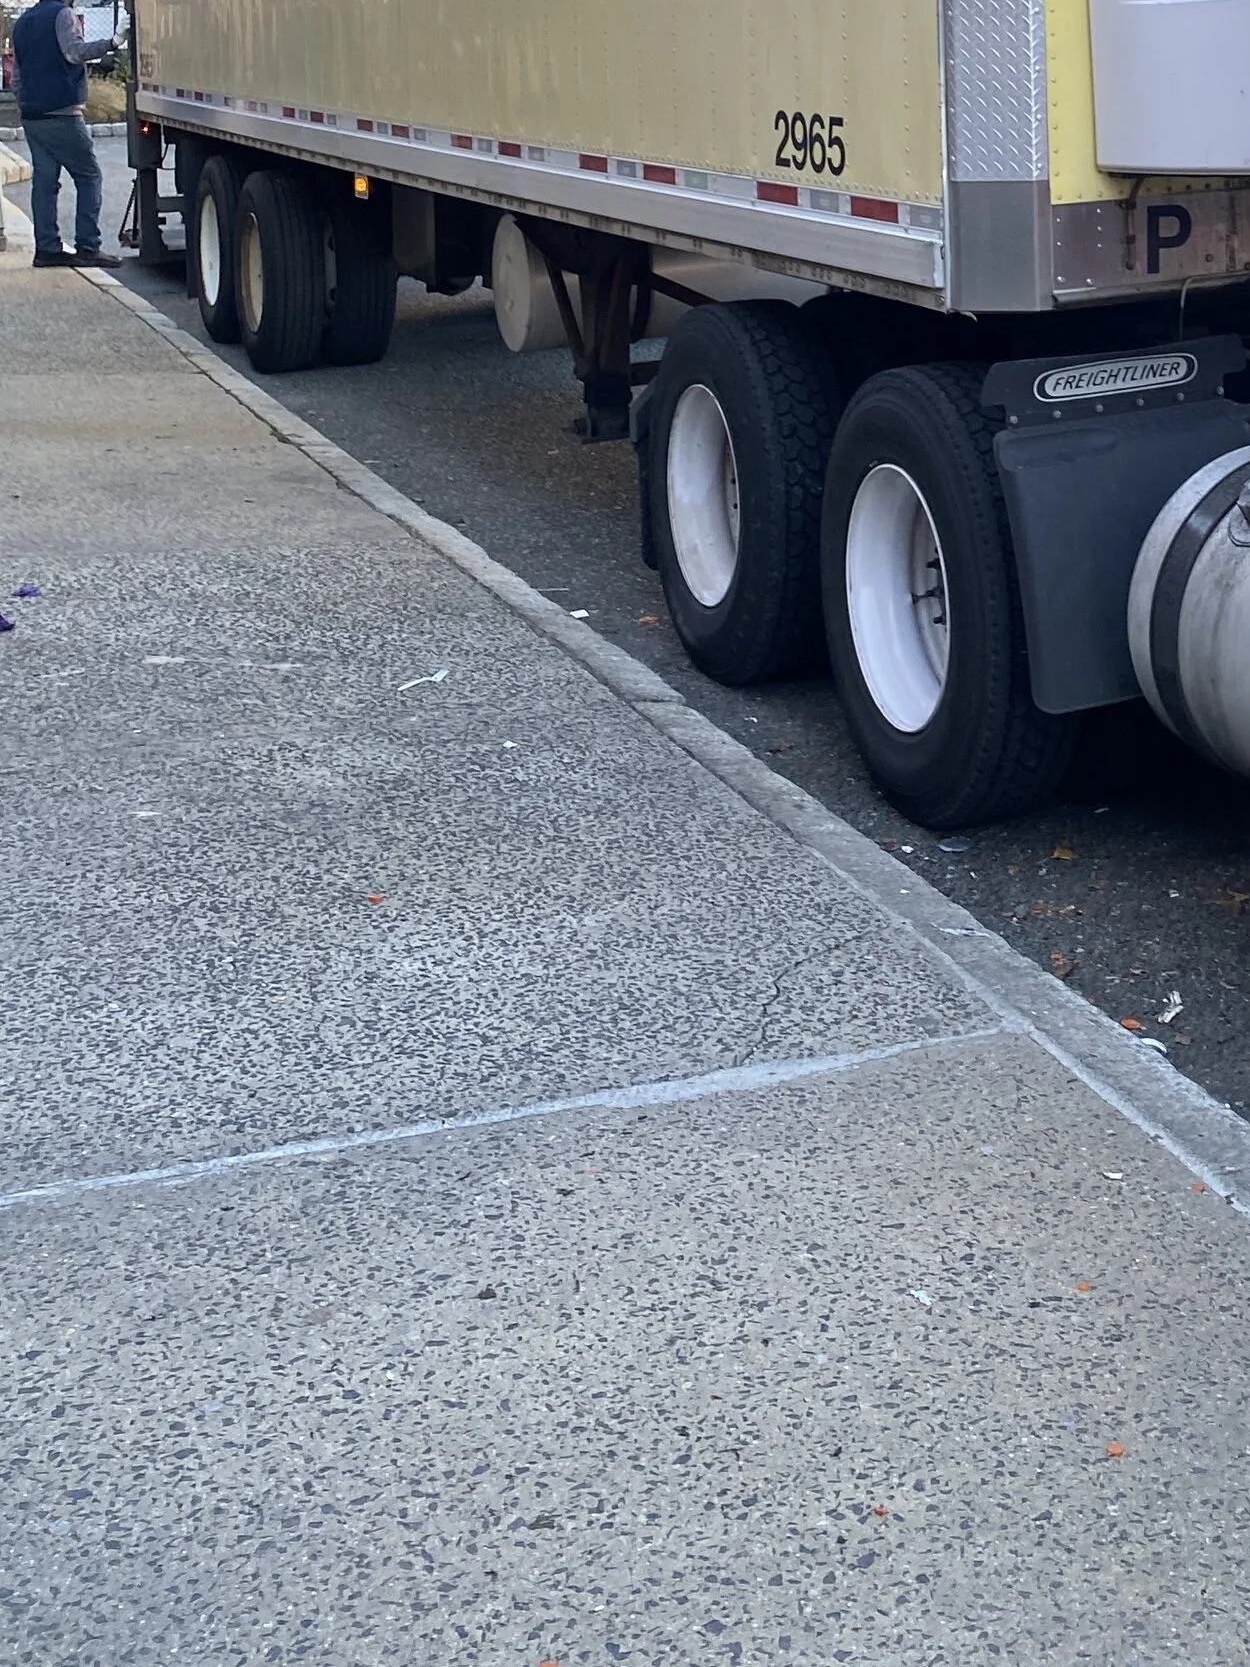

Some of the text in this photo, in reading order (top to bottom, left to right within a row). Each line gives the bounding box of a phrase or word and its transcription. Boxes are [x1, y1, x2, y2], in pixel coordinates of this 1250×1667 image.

[774, 110, 846, 176] 2965
[1146, 204, 1192, 274] P
[1053, 362, 1180, 392] FREIGHTLINER
